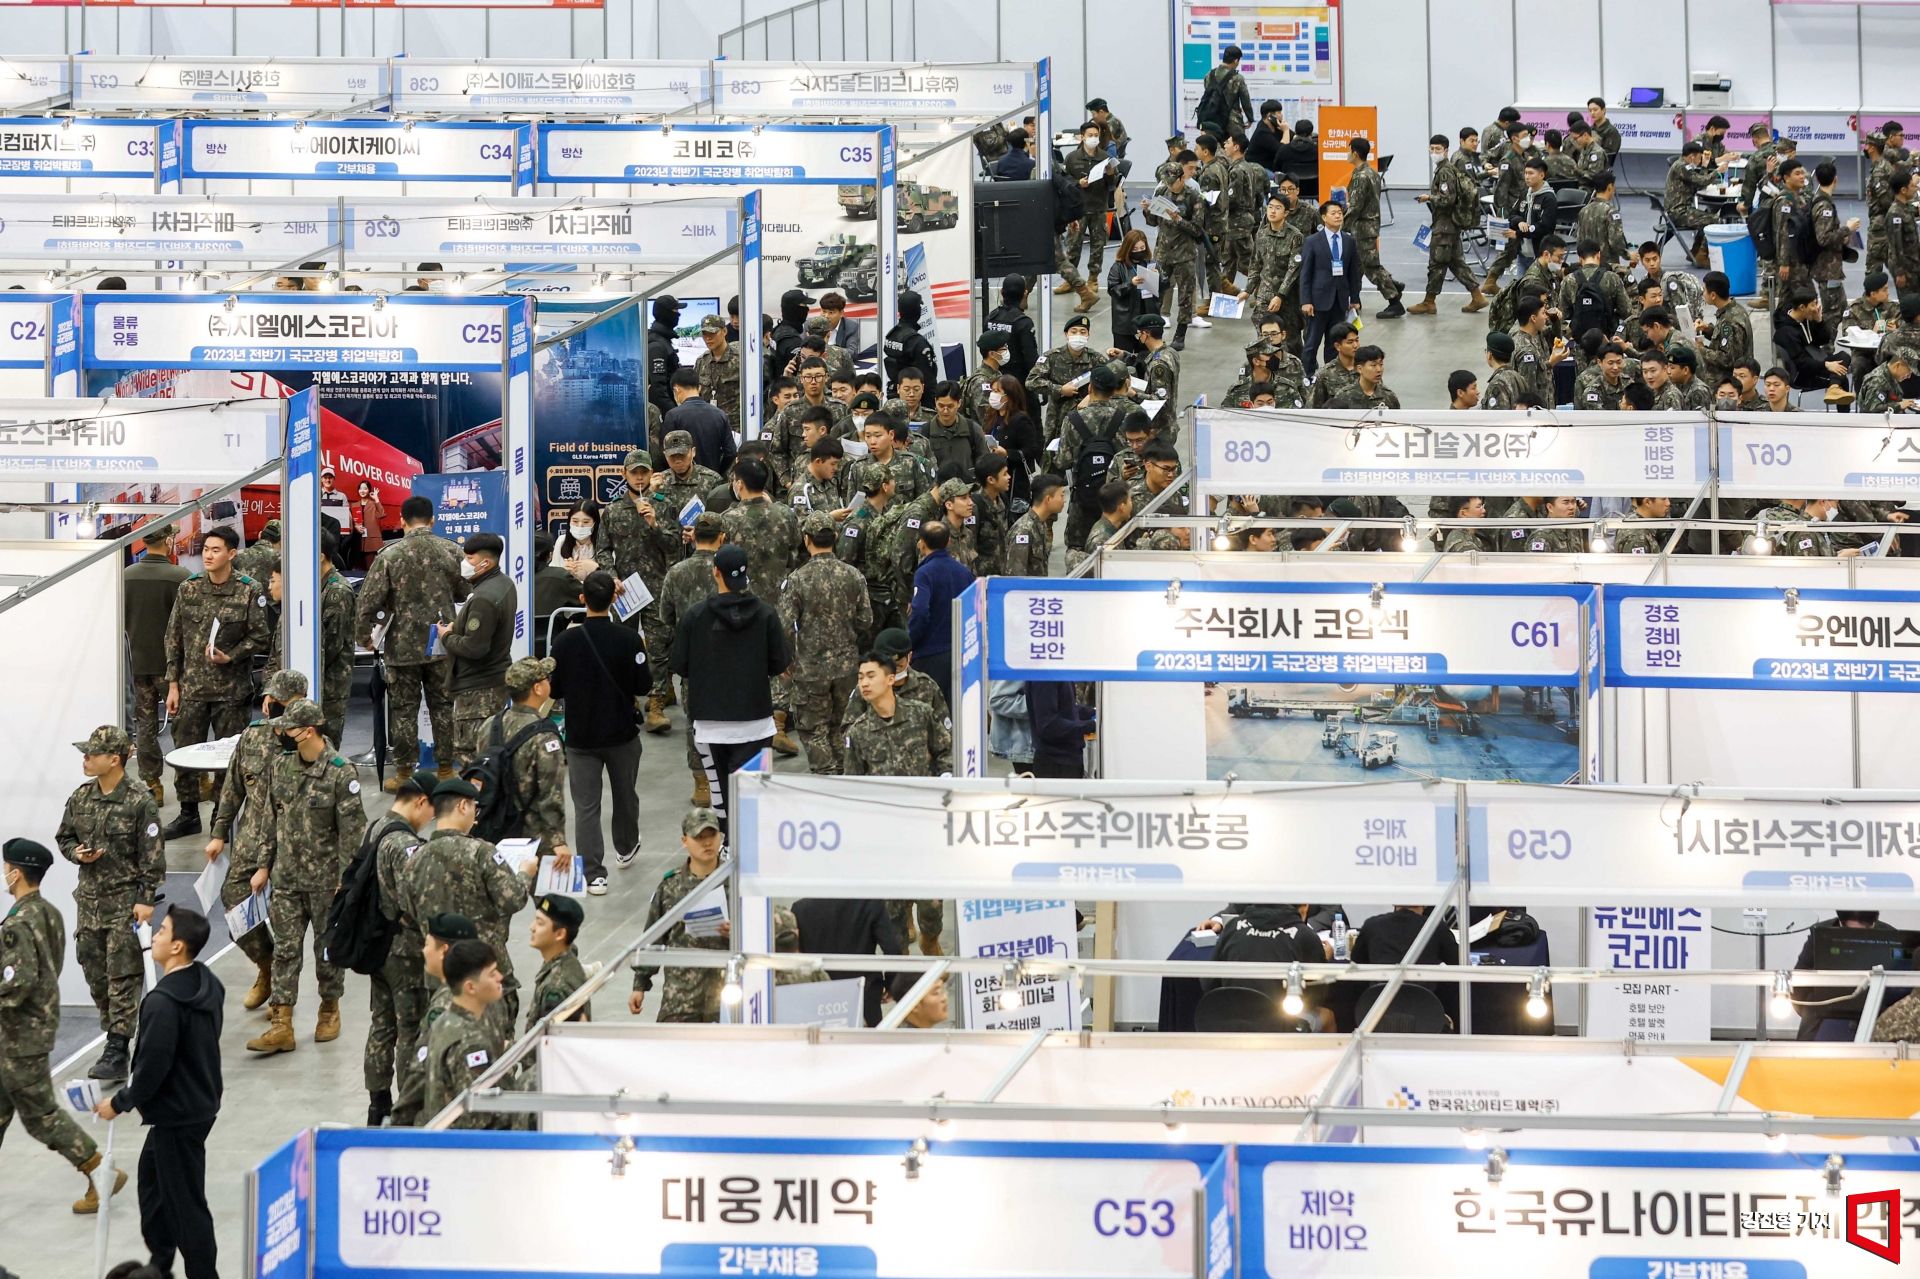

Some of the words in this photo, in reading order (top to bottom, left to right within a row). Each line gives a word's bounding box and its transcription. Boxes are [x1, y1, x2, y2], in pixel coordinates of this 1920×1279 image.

[1328, 129, 1368, 139] 한화시스템
[206, 143, 227, 154] 방산
[480, 145, 513, 160] C34
[562, 147, 583, 158] 방산
[1323, 140, 1347, 149] 신규인력
[840, 147, 872, 162] C35
[337, 163, 376, 174] 간부채용
[634, 166, 669, 177] 2023년
[671, 166, 700, 177] 전반기
[703, 166, 741, 178] 국군장병
[744, 167, 793, 178] 취업박람회
[113, 315, 138, 330] 물류
[113, 332, 138, 347] 유통
[462, 324, 502, 344] C25
[203, 348, 247, 362] 2023년
[250, 348, 286, 363] 전반기
[290, 349, 338, 363] 국군장병
[341, 349, 403, 364] 취업박람회
[135, 370, 157, 392] Wide
[312, 371, 387, 385] 지엘에스코리아가
[390, 371, 418, 385] 고객과
[420, 372, 438, 385] 함께
[440, 372, 473, 386] 합니다.
[549, 442, 576, 453] Field
[578, 442, 590, 453] of
[340, 455, 383, 482] MOVER
[385, 472, 400, 487] GLS
[401, 476, 412, 489] KO
[438, 512, 487, 522] 지엘에스코리아
[1029, 598, 1063, 616] 경호
[1644, 605, 1679, 623] 경호
[1029, 620, 1064, 638] 경비
[1174, 607, 1303, 639] 주식회사
[1795, 614, 1920, 649] 유엔에스
[1511, 621, 1559, 648] C61
[1645, 627, 1680, 645] 경비
[1029, 643, 1065, 660] 보안
[1646, 650, 1681, 667] 보안
[1154, 653, 1213, 671] 2023년
[1216, 653, 1267, 672] 전반기
[1272, 654, 1338, 673] 국군장병
[1343, 655, 1427, 674] 취업박람회
[1771, 661, 1829, 680] 2023년
[1833, 662, 1883, 681] 전반기
[1608, 933, 1689, 970] 코리아
[1622, 983, 1641, 995] 모집
[1644, 984, 1671, 995] PART
[1648, 1003, 1665, 1014] 보안
[376, 1175, 430, 1203] 제약
[661, 1175, 878, 1225] 대웅제약
[1300, 1189, 1355, 1218] 제약
[363, 1210, 442, 1237] 바이오
[1093, 1199, 1176, 1238] C53
[1289, 1224, 1368, 1252] 바이오
[718, 1246, 819, 1276] 간부채용
